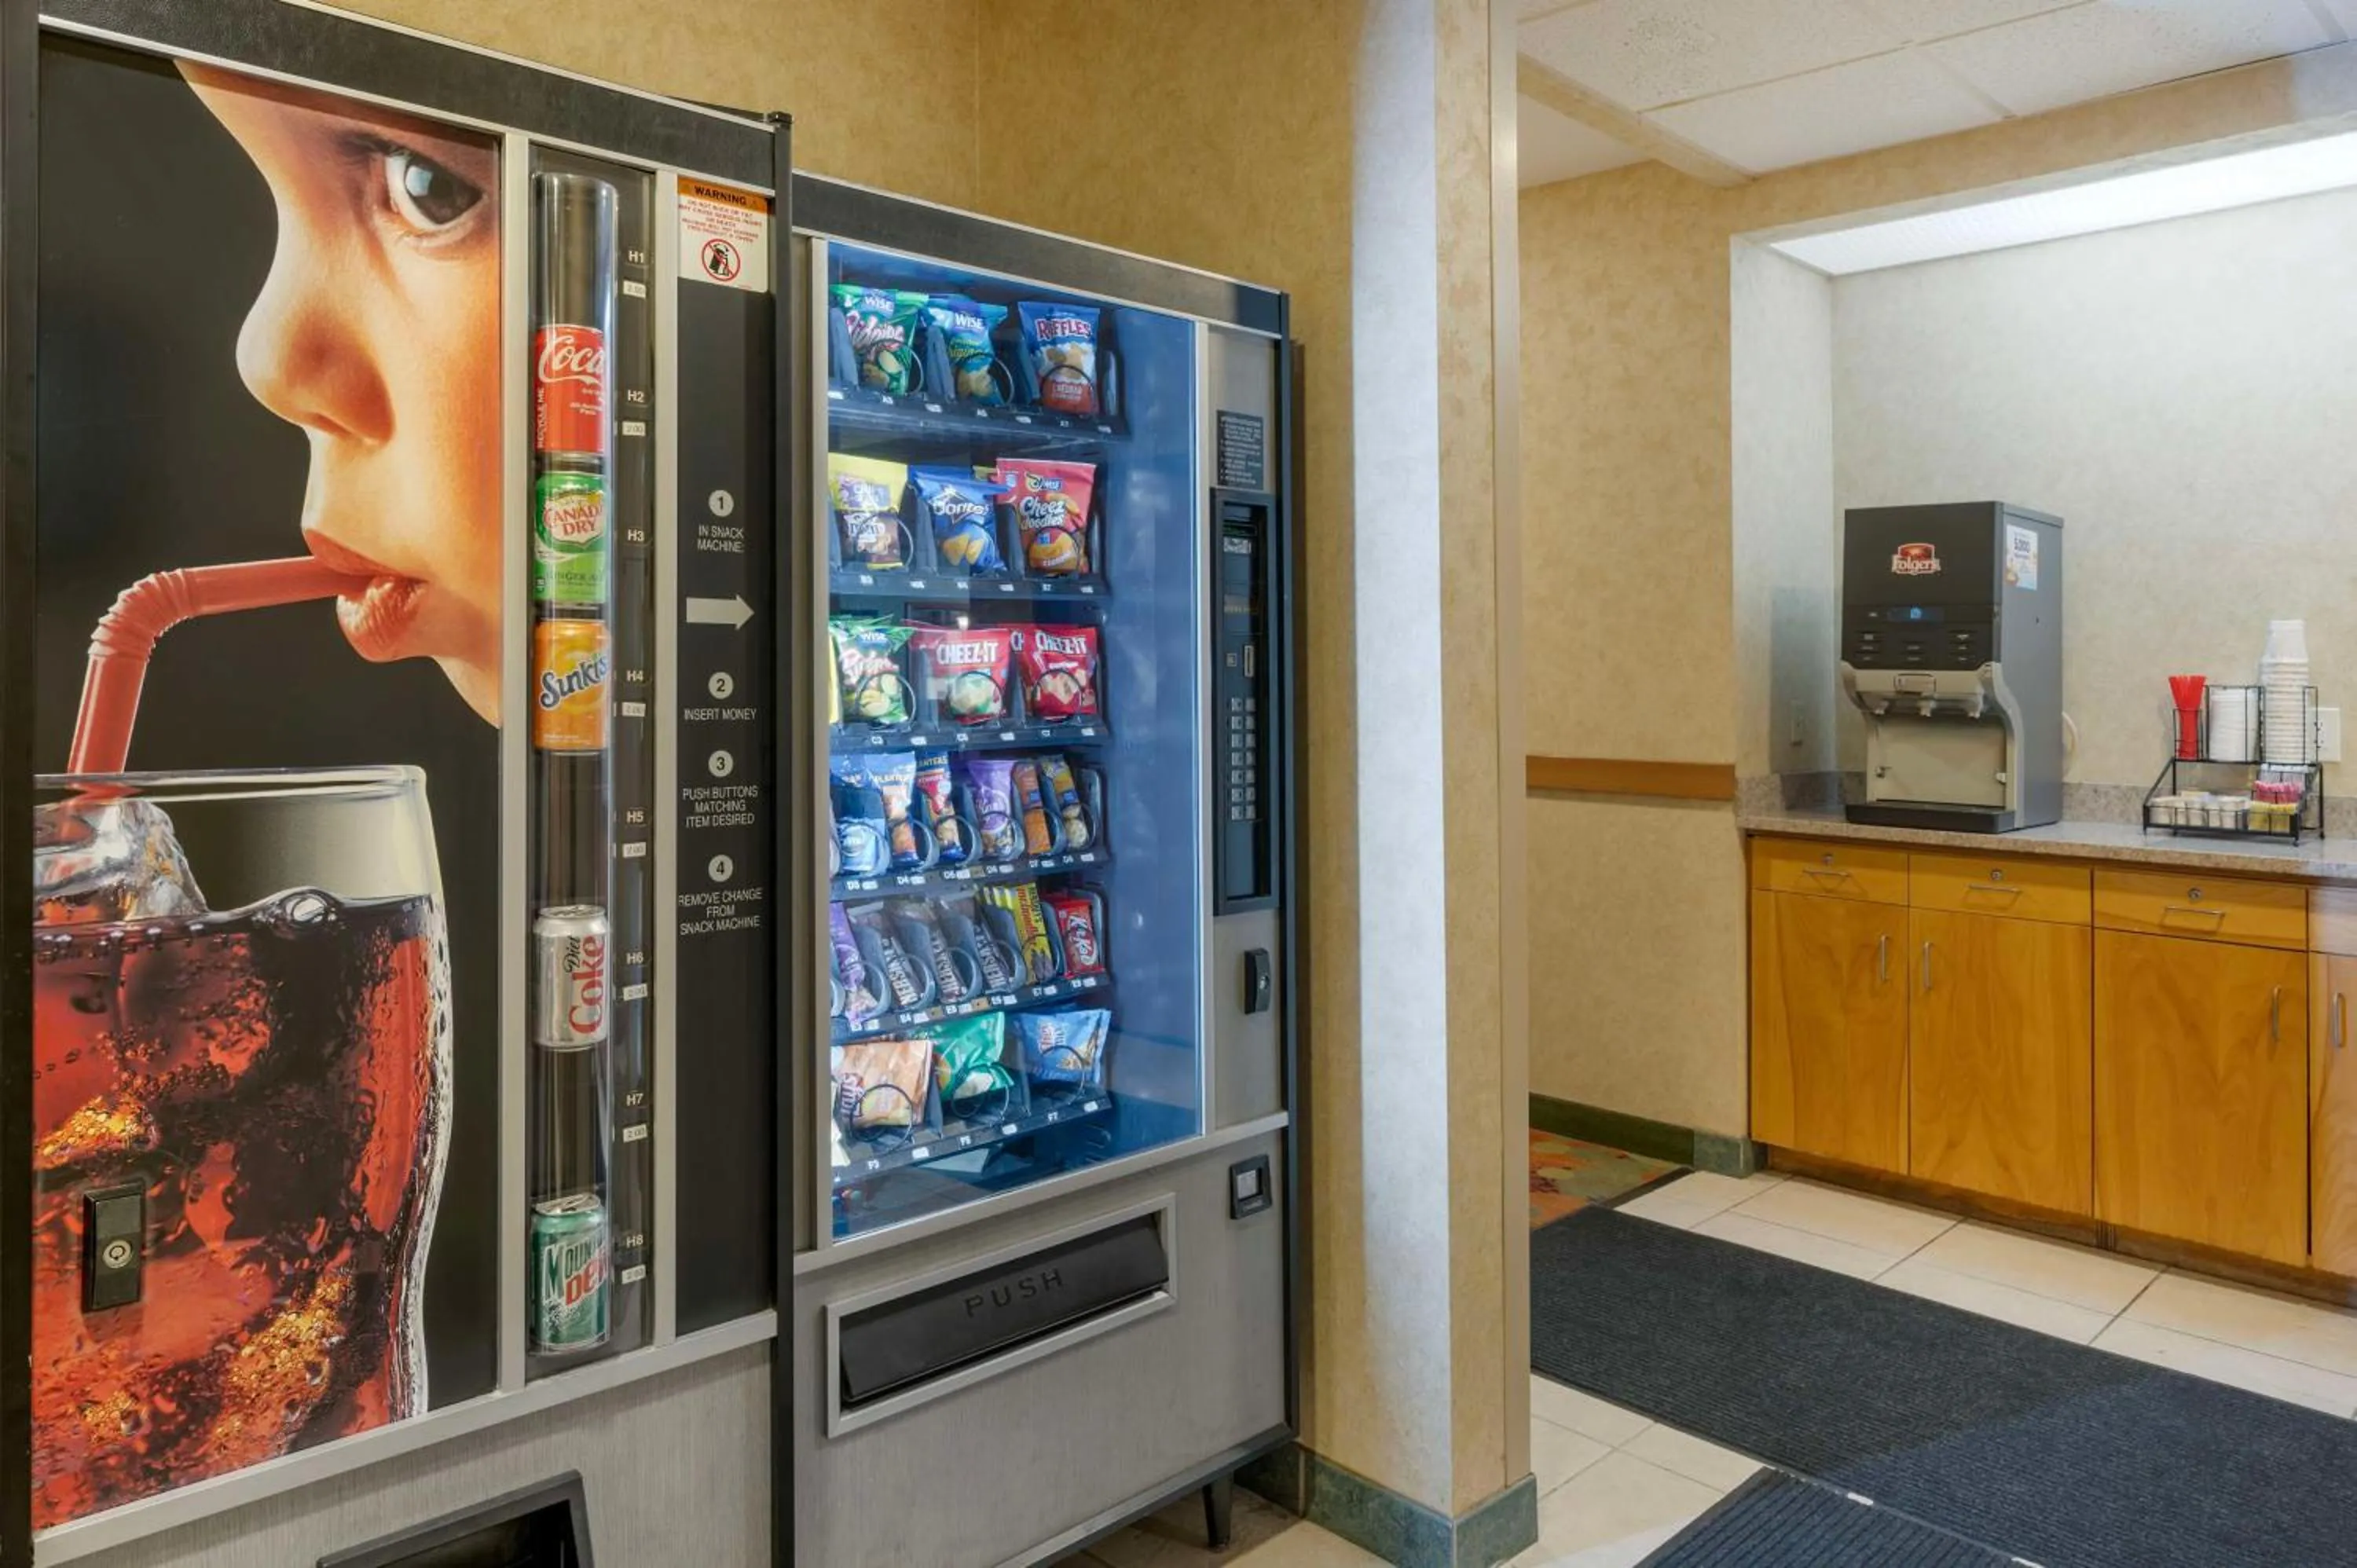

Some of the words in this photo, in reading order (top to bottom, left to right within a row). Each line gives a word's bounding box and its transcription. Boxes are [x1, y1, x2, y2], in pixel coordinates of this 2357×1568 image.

[695, 185, 746, 206] WARNING
[629, 250, 643, 263] H1
[955, 313, 985, 330] WISE
[628, 389, 644, 403] H2
[717, 496, 724, 510] 1
[544, 504, 603, 529] CANAD
[563, 518, 596, 536] DRY
[698, 525, 709, 537] IN
[711, 526, 745, 540] SNACK
[628, 529, 644, 542] H3
[697, 538, 745, 553] MACHINE
[937, 642, 999, 665] CHEEZ-IT
[539, 655, 608, 710] Sunkis
[626, 669, 643, 682] H4
[716, 679, 725, 692] 2
[684, 708, 719, 721] INSERT
[722, 708, 757, 721] MONEY
[716, 757, 725, 771] 3
[682, 788, 709, 800] PUSH
[712, 786, 759, 800] BUTTONS
[695, 800, 746, 813] MATCHING
[626, 810, 644, 823] H5
[686, 815, 709, 829] ITEM
[712, 813, 755, 826] DESIRED
[716, 861, 725, 876] 4
[678, 892, 720, 907] REMOVE
[721, 888, 763, 903] CHANGE
[706, 904, 735, 918] FROM
[680, 920, 714, 936] SNACK
[716, 915, 761, 932] MACHINE
[563, 935, 581, 973] Diet
[626, 951, 643, 965] H6
[568, 935, 605, 1035] Coke
[626, 1093, 644, 1106] H7
[626, 1233, 643, 1247] H8
[964, 1267, 1065, 1318] PUSH
